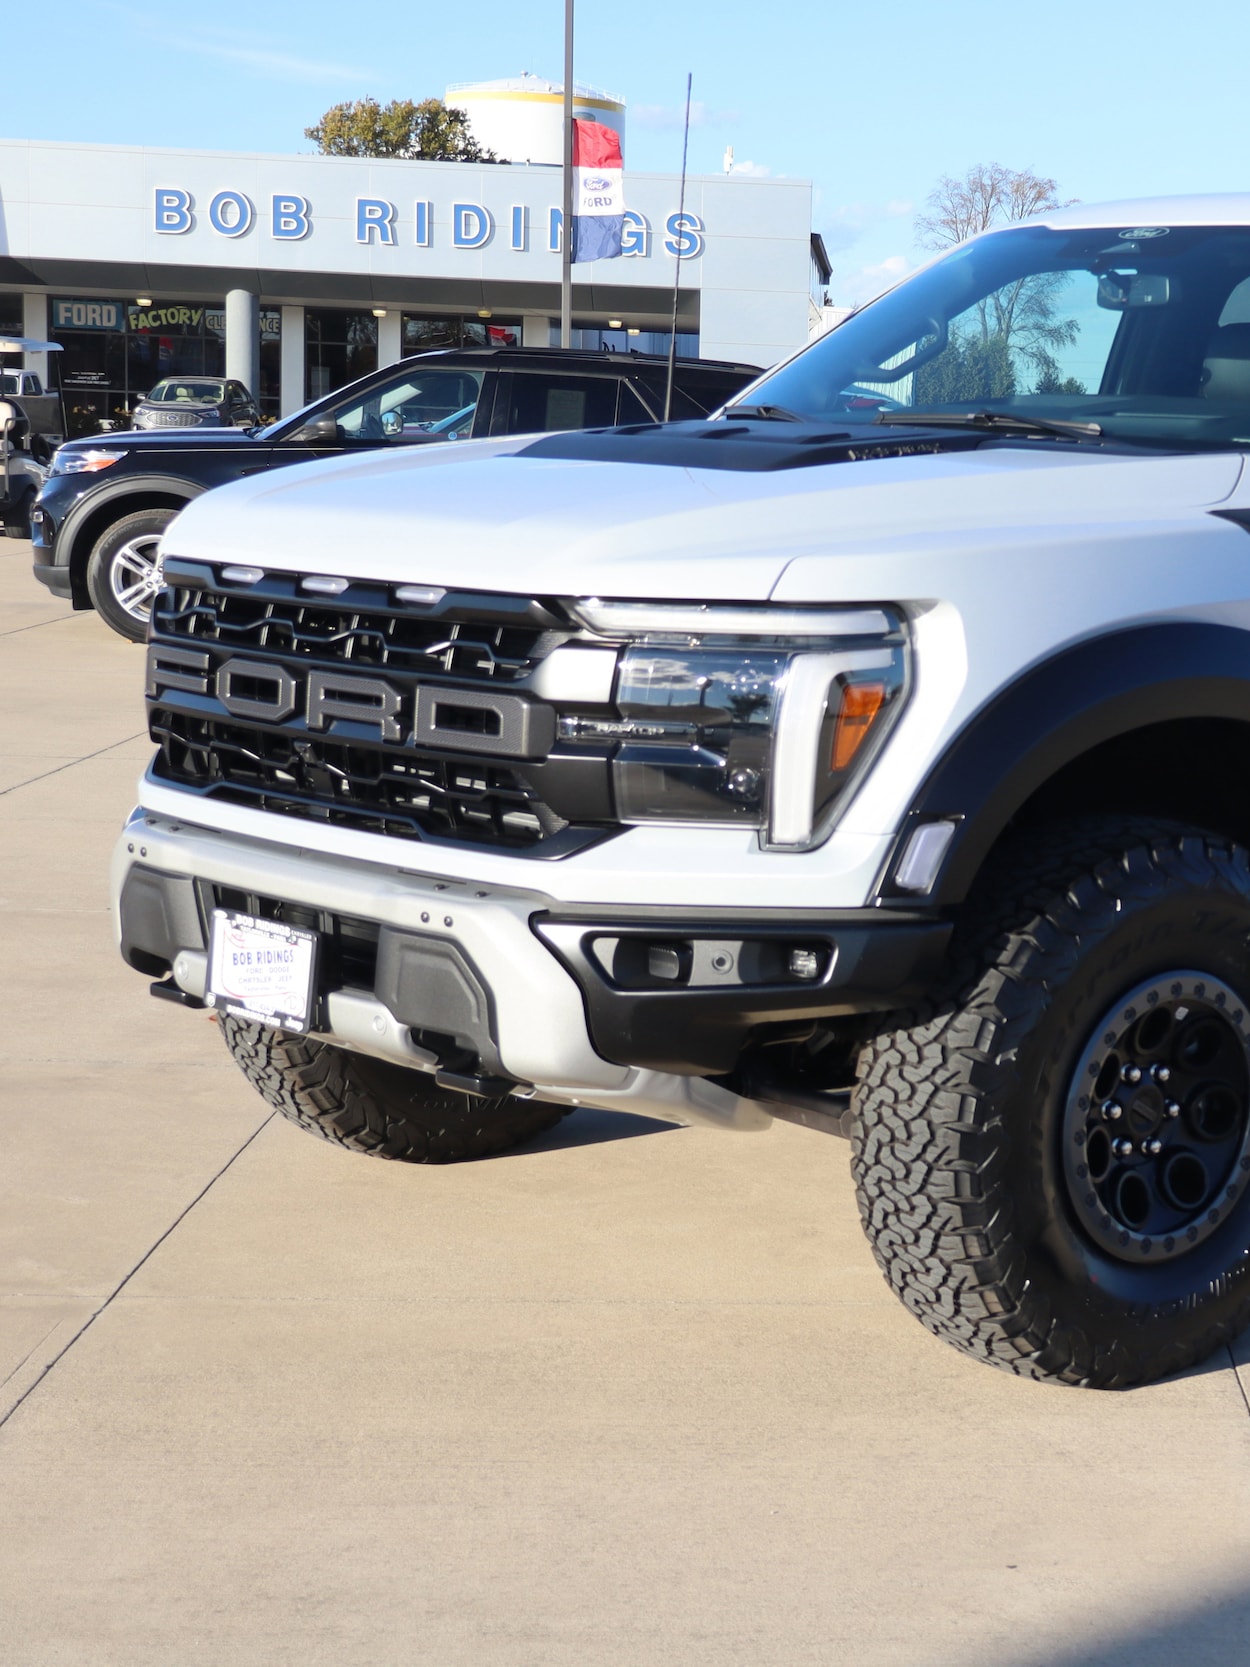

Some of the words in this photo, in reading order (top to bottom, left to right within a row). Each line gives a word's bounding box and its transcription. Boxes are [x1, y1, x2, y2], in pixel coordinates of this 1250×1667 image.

[153, 186, 312, 242] BOB
[583, 196, 613, 208] FORD
[58, 302, 117, 328] FORD
[129, 306, 204, 330] FACTORY
[205, 315, 281, 332] CLENCE
[146, 642, 532, 758] FORD
[235, 914, 254, 928] BOB
[255, 918, 292, 937] RIDINGS
[232, 951, 253, 966] BOB
[256, 949, 294, 965] RIDINGS
